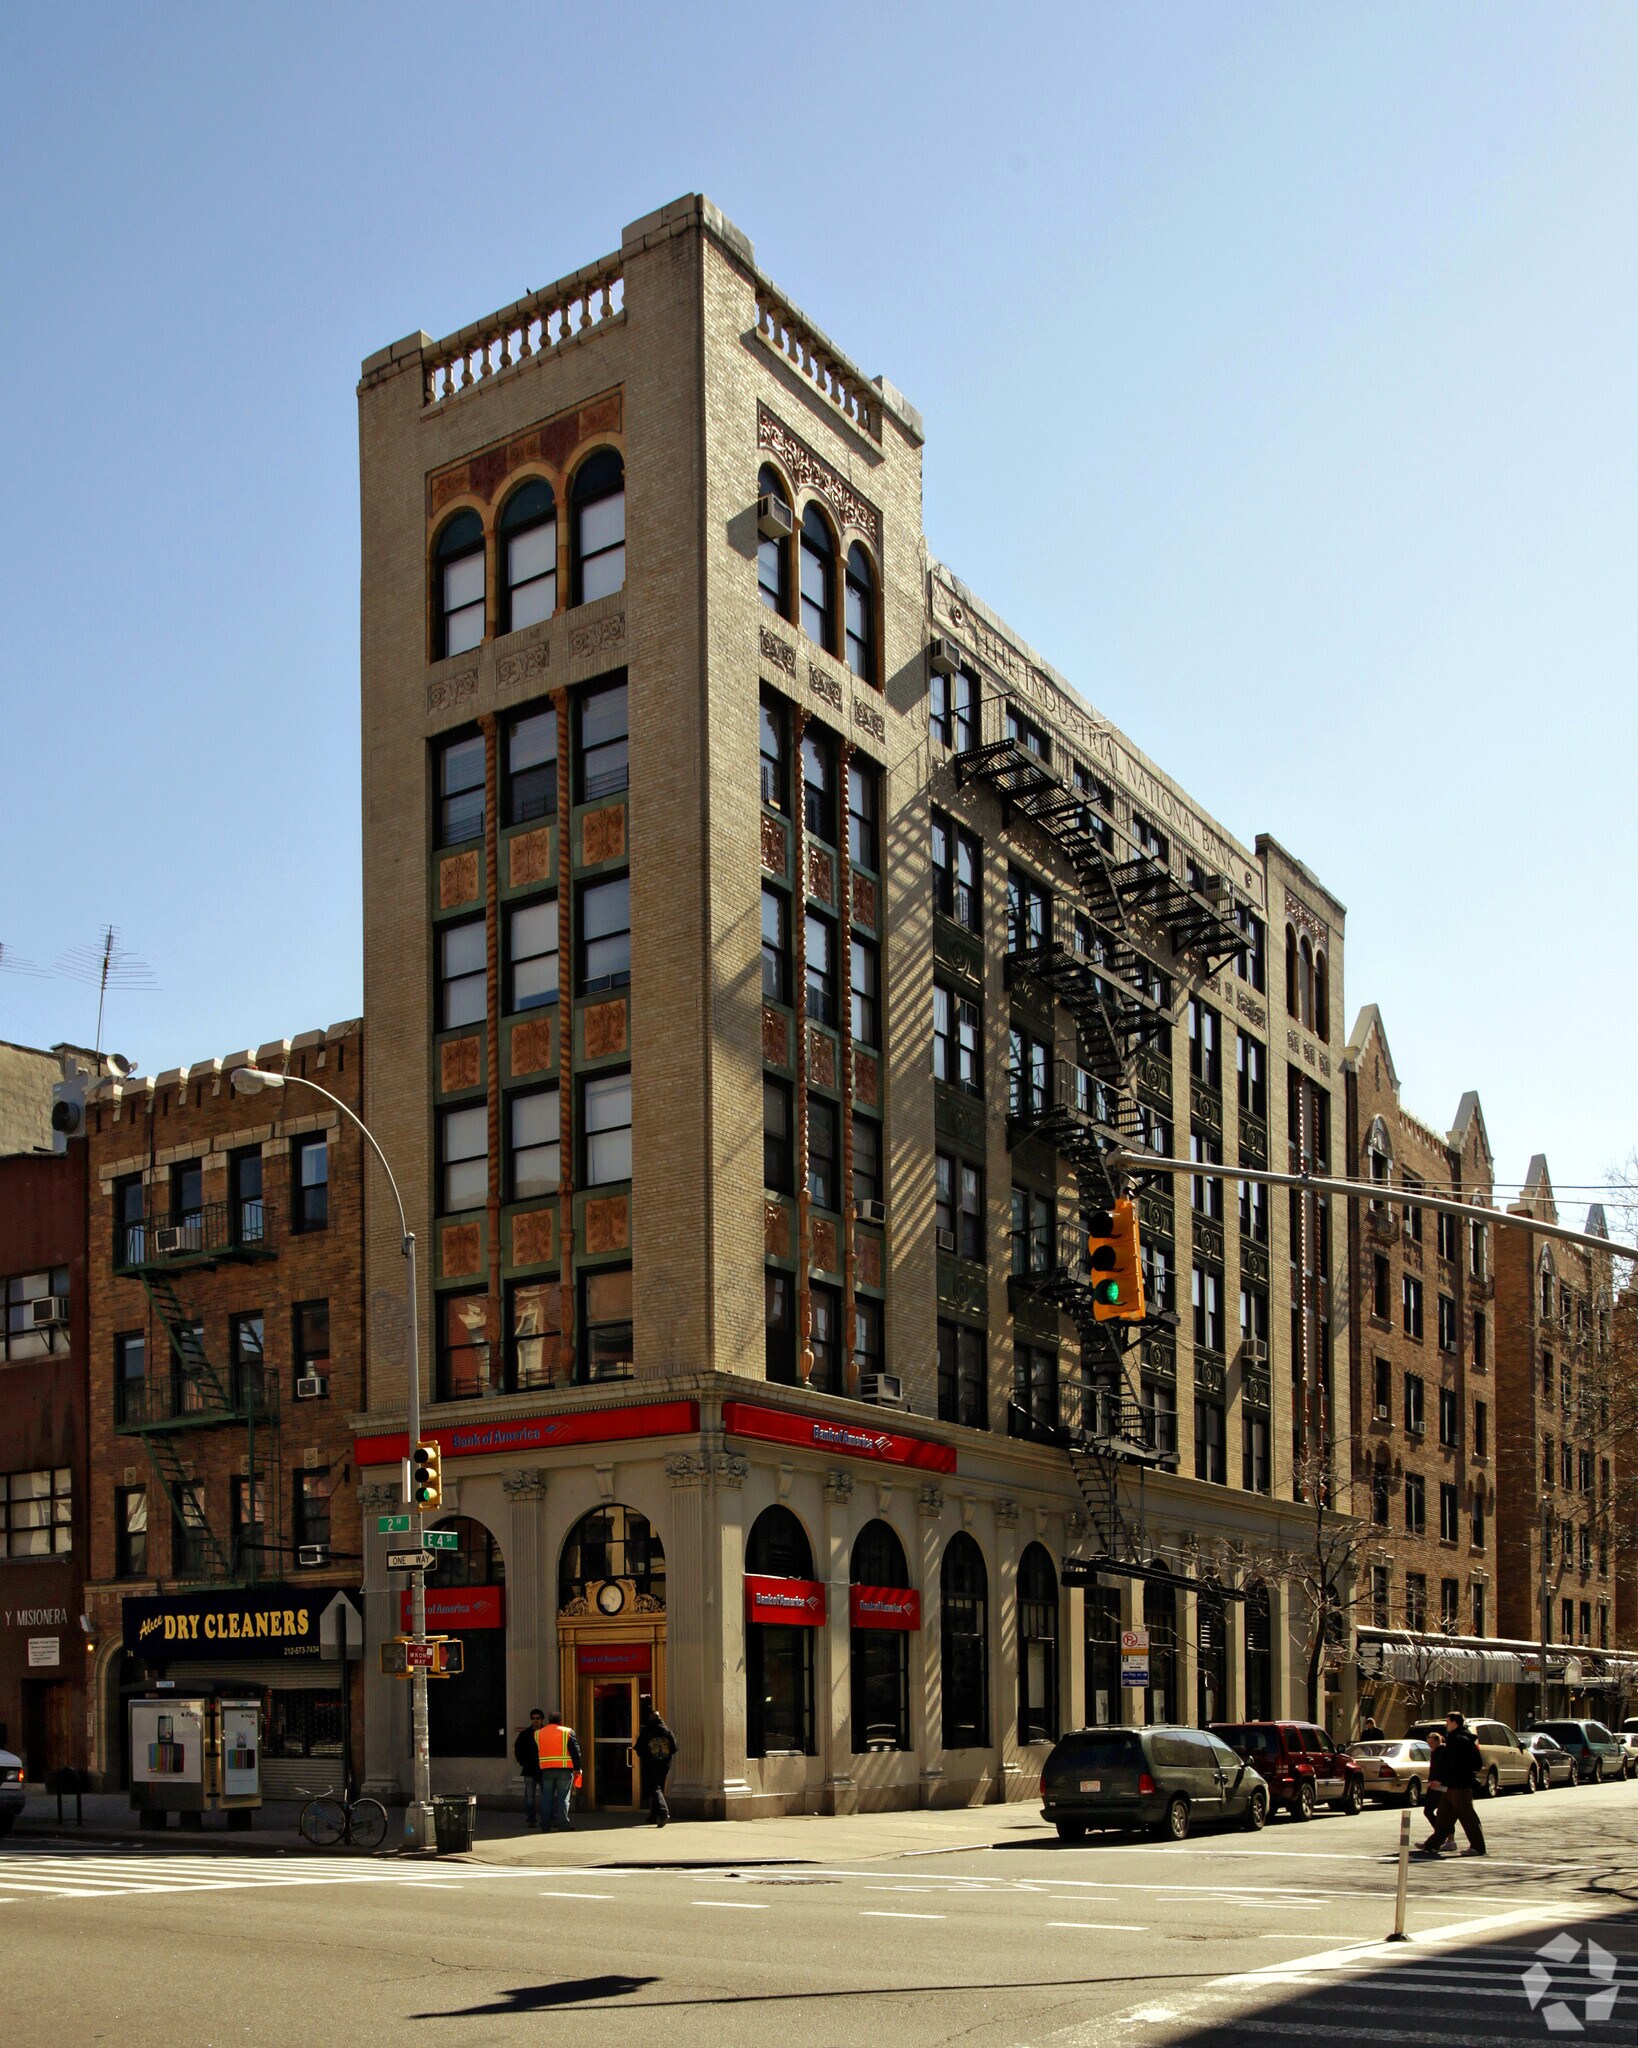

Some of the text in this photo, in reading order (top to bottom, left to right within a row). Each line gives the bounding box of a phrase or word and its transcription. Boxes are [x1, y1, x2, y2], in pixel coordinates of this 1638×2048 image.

[978, 621, 1236, 877] THE INDUSTRIAL NATIONAL BANK
[453, 1426, 541, 1448] Bank of America
[814, 1424, 874, 1449] Bank of America
[387, 1518, 394, 1531] 2
[427, 1534, 433, 1547] E
[437, 1534, 443, 1547] 4
[392, 1554, 430, 1565] ONE WAY
[427, 1603, 436, 1614] of
[436, 1602, 470, 1614] America
[755, 1592, 773, 1605] Bank
[780, 1594, 806, 1608] America
[5, 1608, 68, 1627] Y MISIONERA
[139, 1608, 309, 1641] Alice DRY CLEANERS
